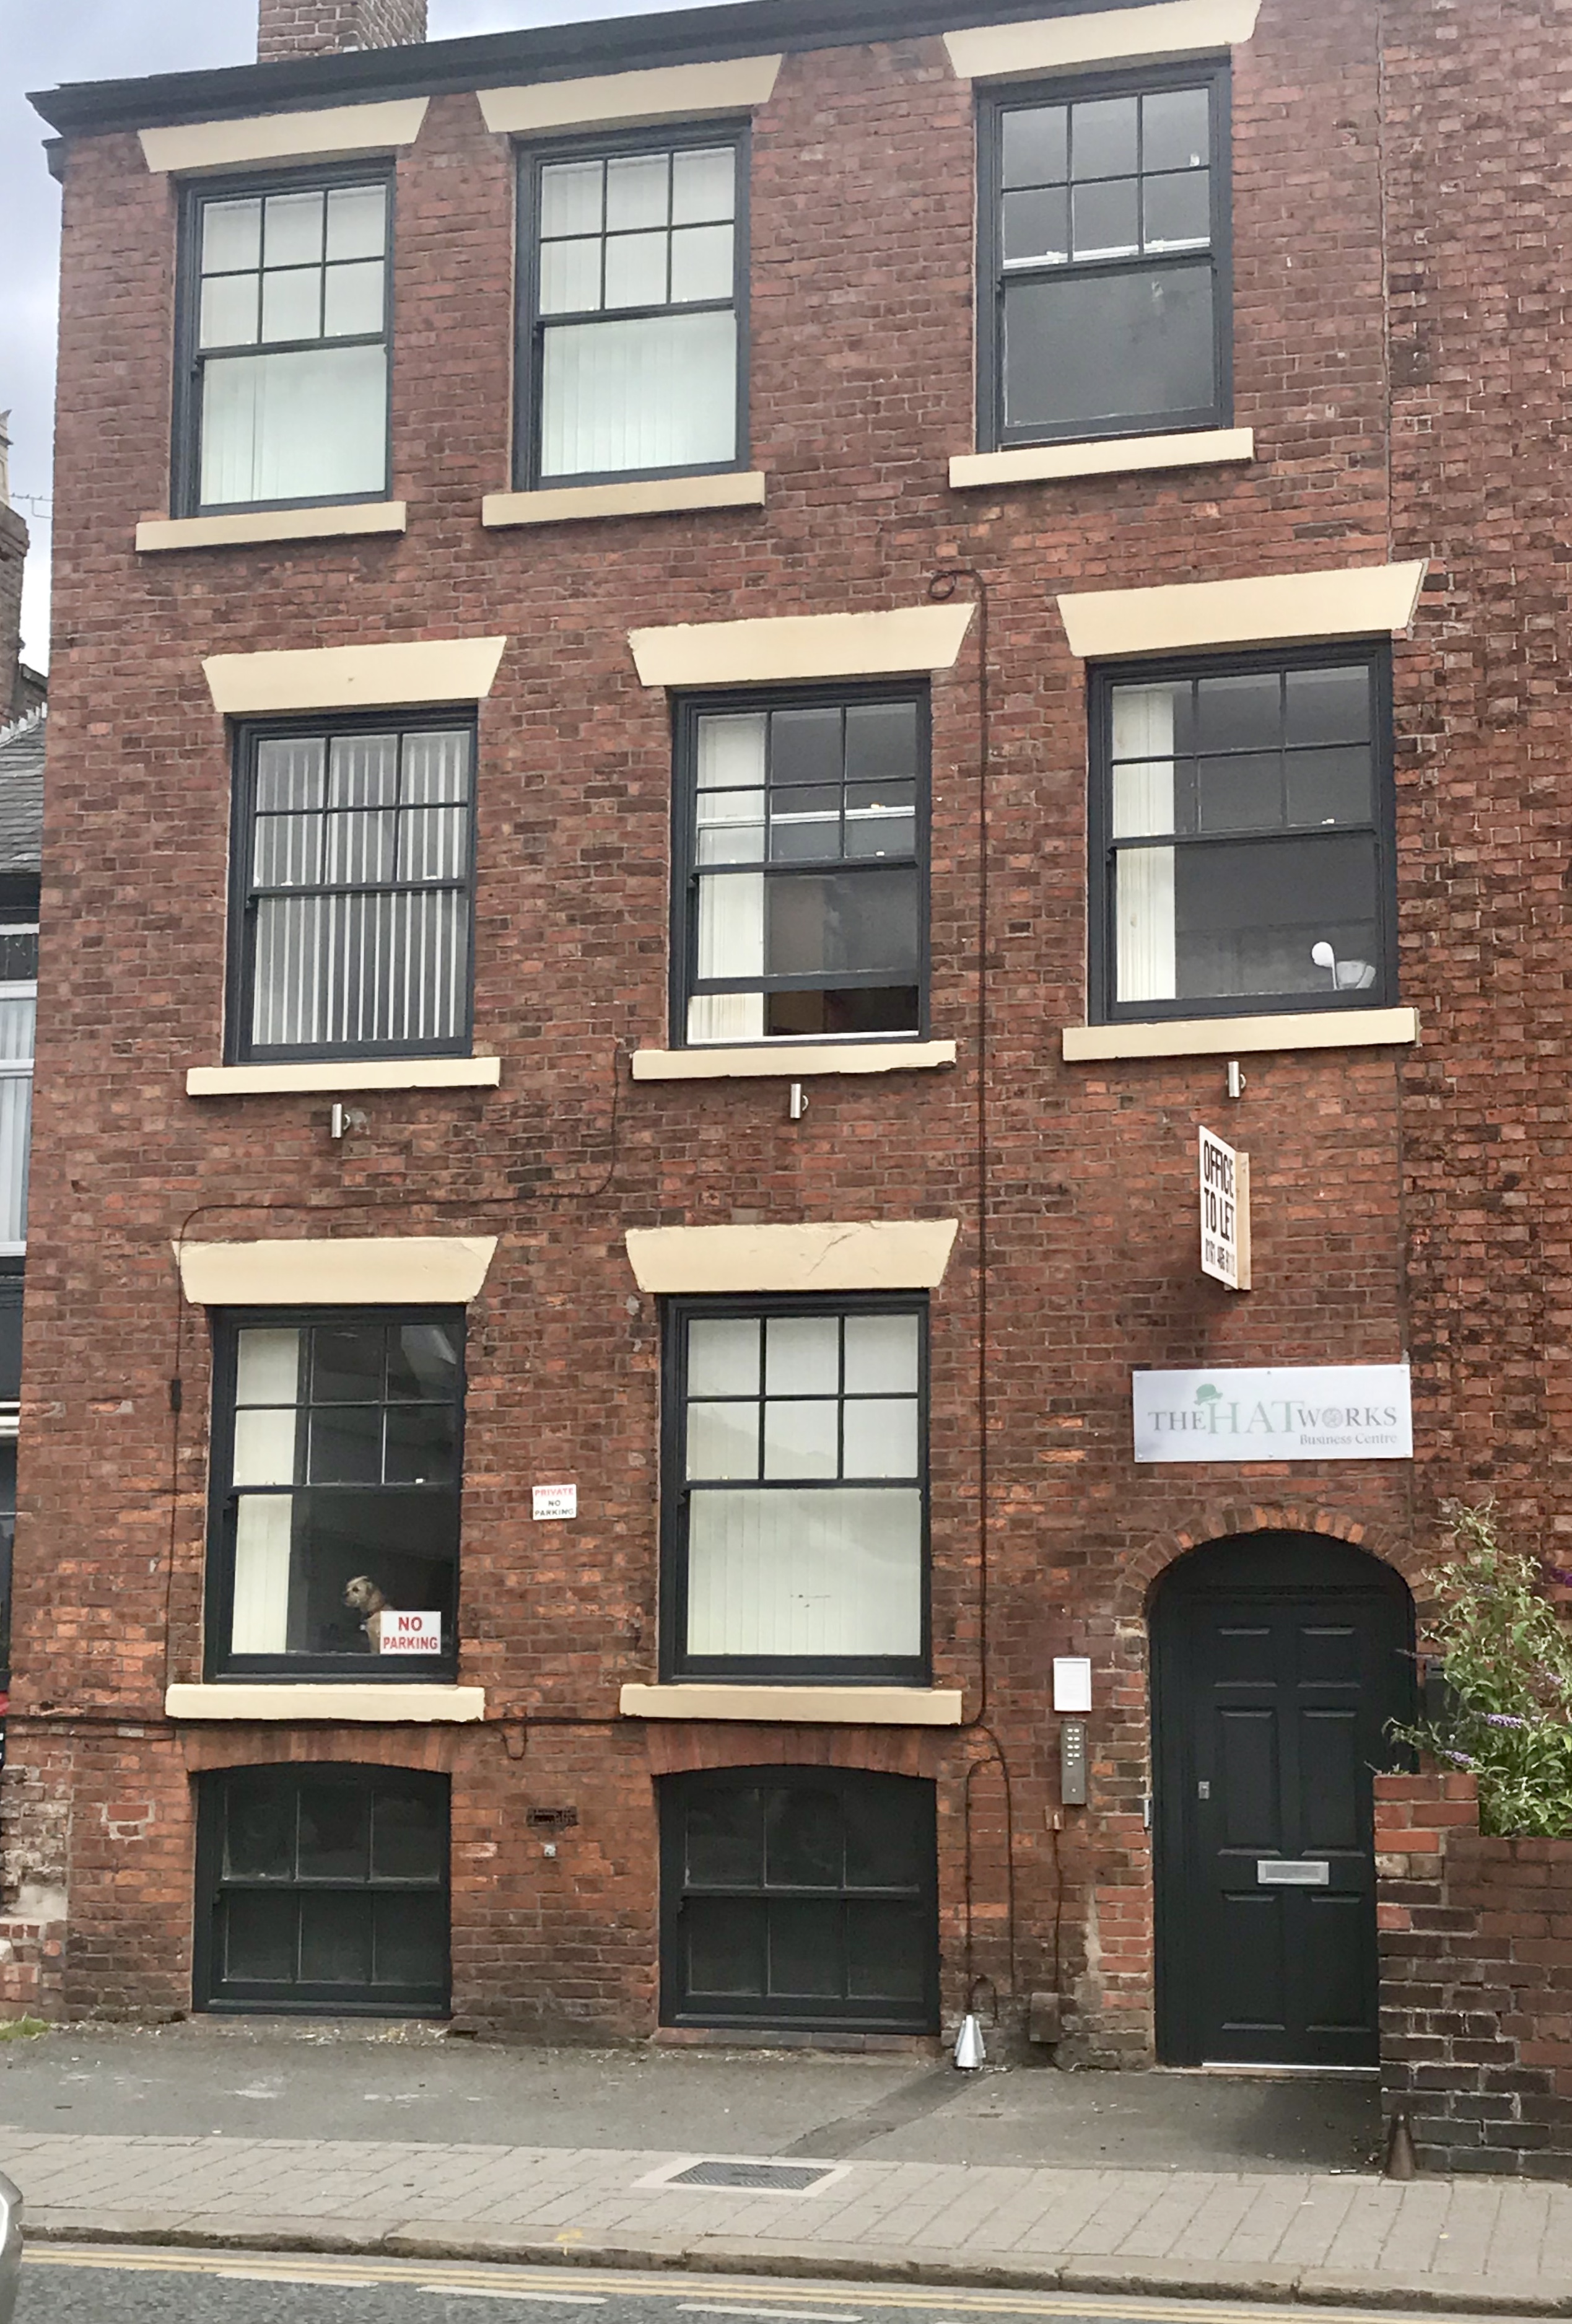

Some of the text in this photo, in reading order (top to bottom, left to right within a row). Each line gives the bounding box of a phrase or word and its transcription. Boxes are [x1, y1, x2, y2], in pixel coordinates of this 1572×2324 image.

[1203, 1140, 1234, 1199] OFFICE
[1203, 1187, 1234, 1244] TO LET
[1148, 1411, 1206, 1431] THE
[1299, 1431, 1398, 1446] Business Centre
[535, 1488, 573, 1496] PRIVATE
[398, 1617, 422, 1631] NO
[383, 1637, 438, 1649] PARKING
